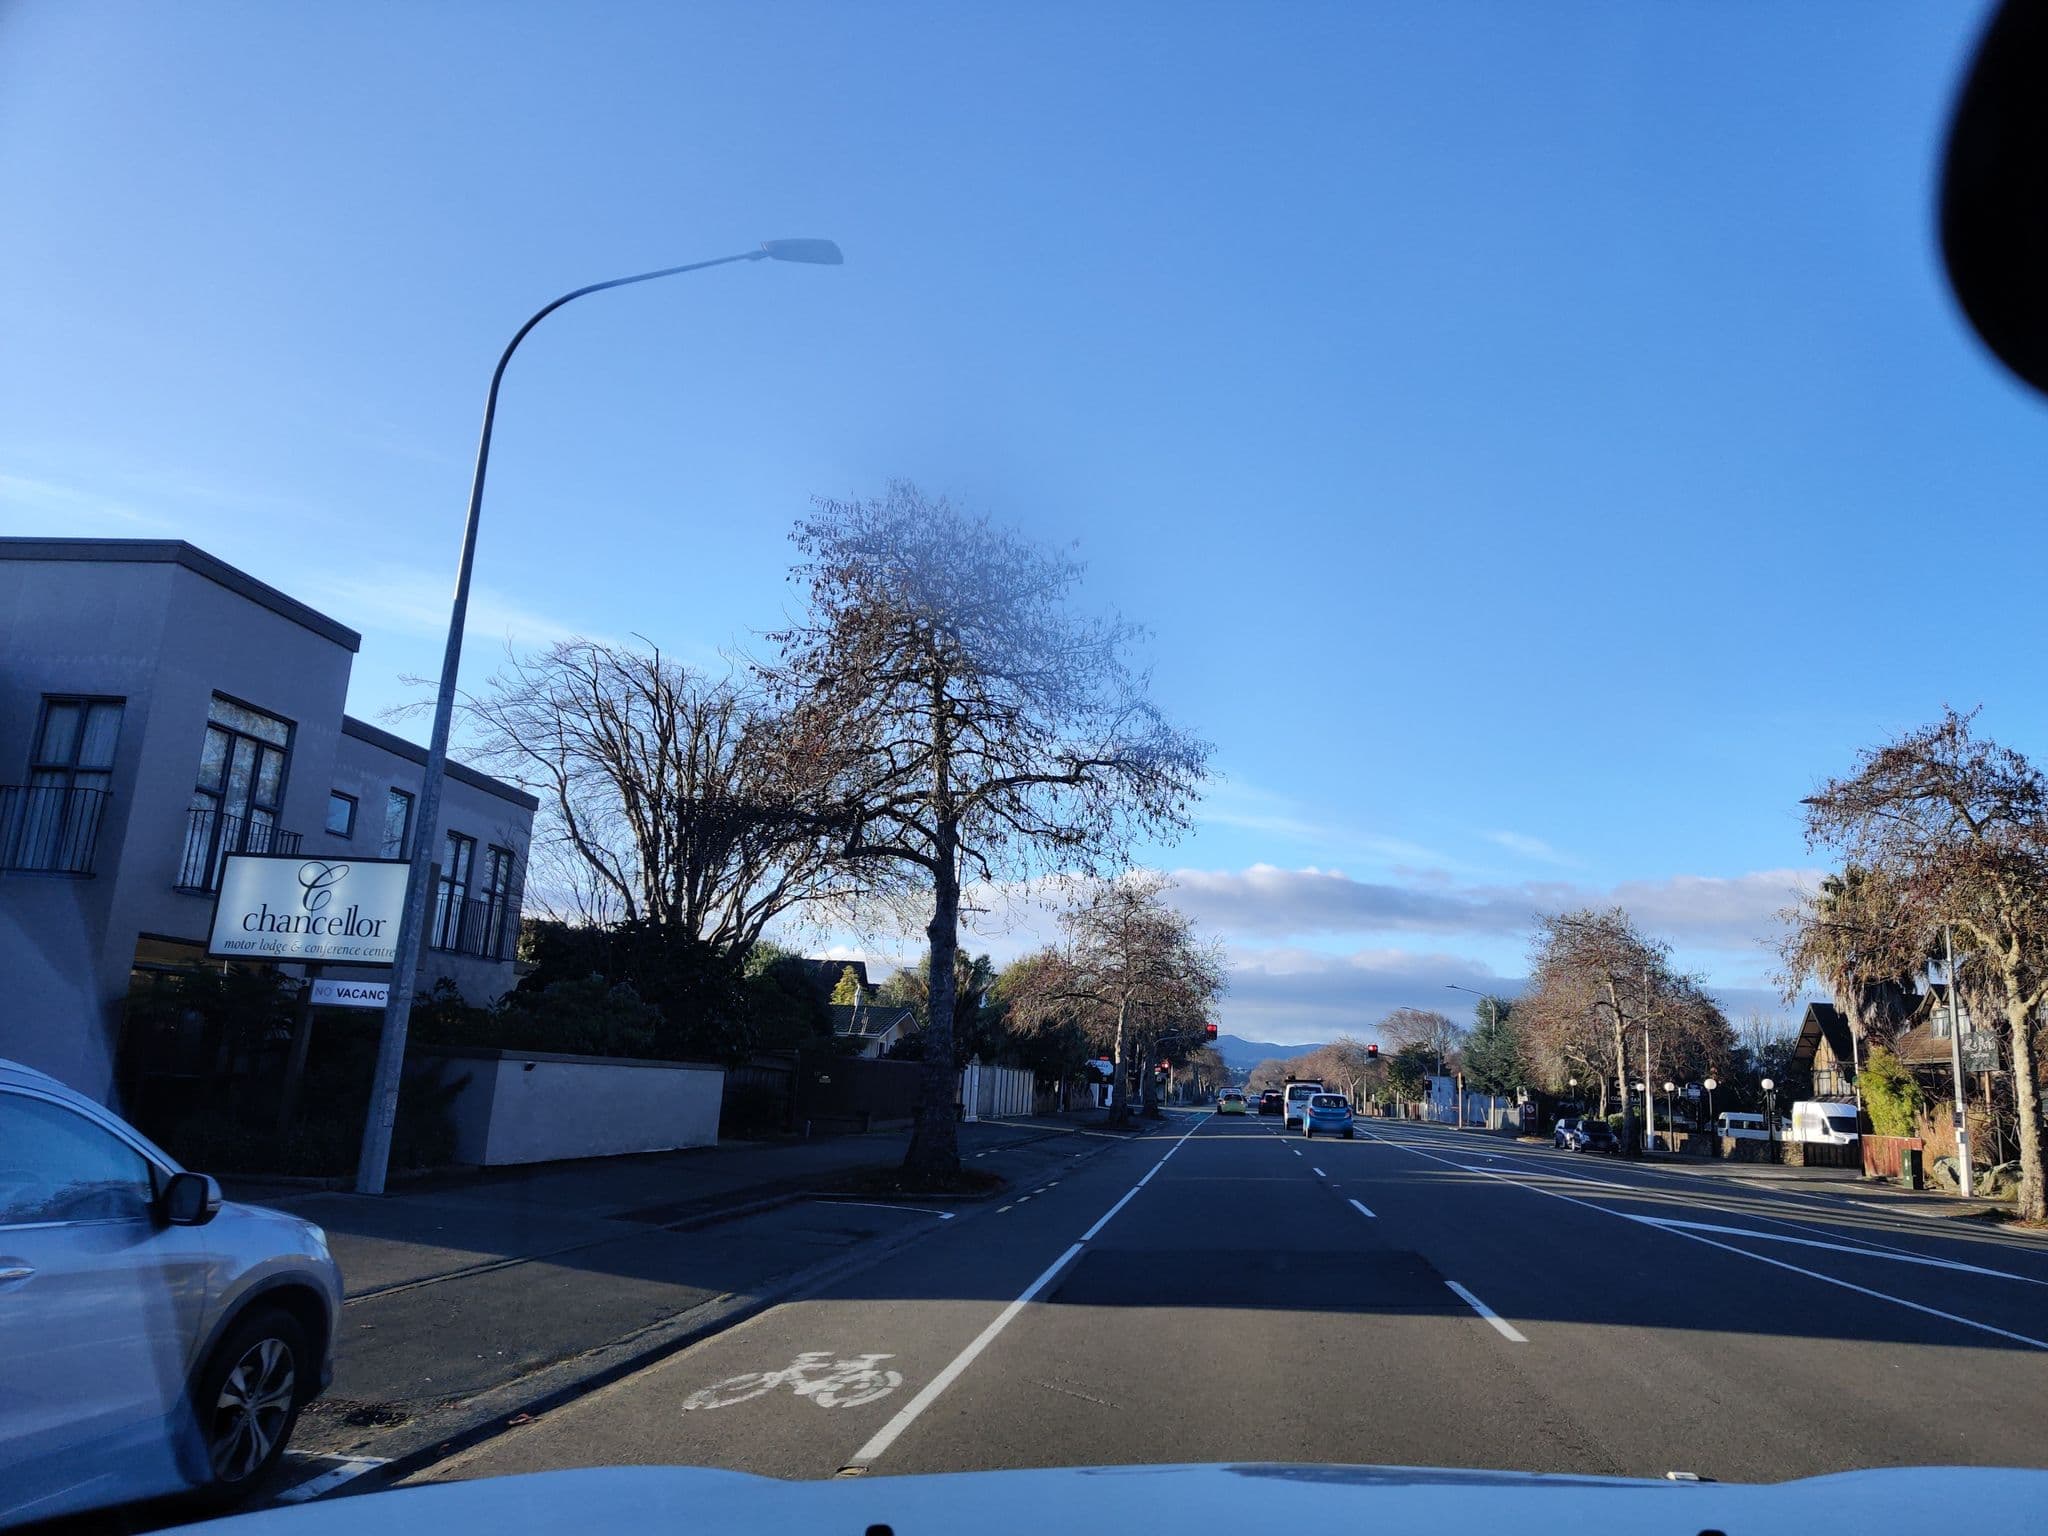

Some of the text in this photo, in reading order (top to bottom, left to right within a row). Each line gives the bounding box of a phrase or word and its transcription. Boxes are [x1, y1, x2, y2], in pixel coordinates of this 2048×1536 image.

[243, 903, 387, 938] chancellor
[223, 938, 258, 951] motor
[258, 937, 287, 955] lodge
[290, 940, 301, 952] &
[304, 941, 361, 958] conference
[314, 986, 333, 997] NO
